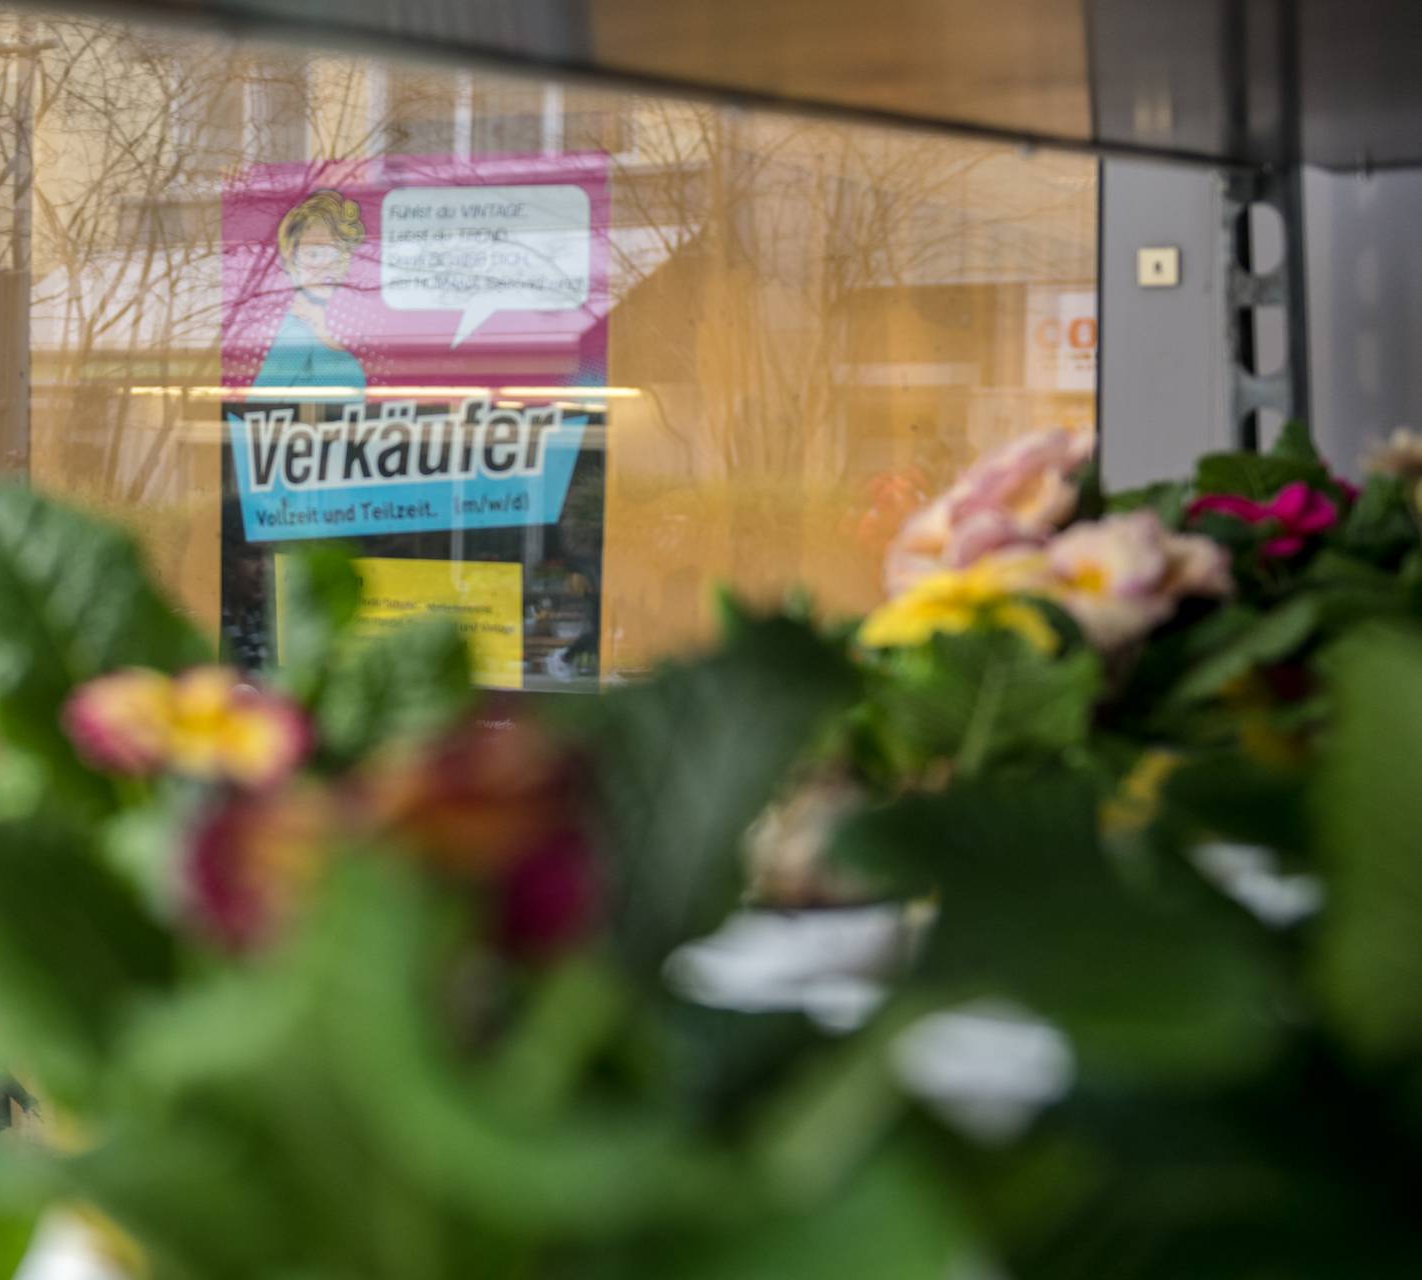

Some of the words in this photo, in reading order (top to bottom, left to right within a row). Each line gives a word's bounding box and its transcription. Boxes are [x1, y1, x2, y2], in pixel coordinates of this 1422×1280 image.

[435, 203, 455, 219] du
[249, 400, 554, 487] Verkäufer
[256, 499, 319, 526] Vollzeit
[322, 504, 355, 525] und
[361, 500, 438, 521] Teilzeit.
